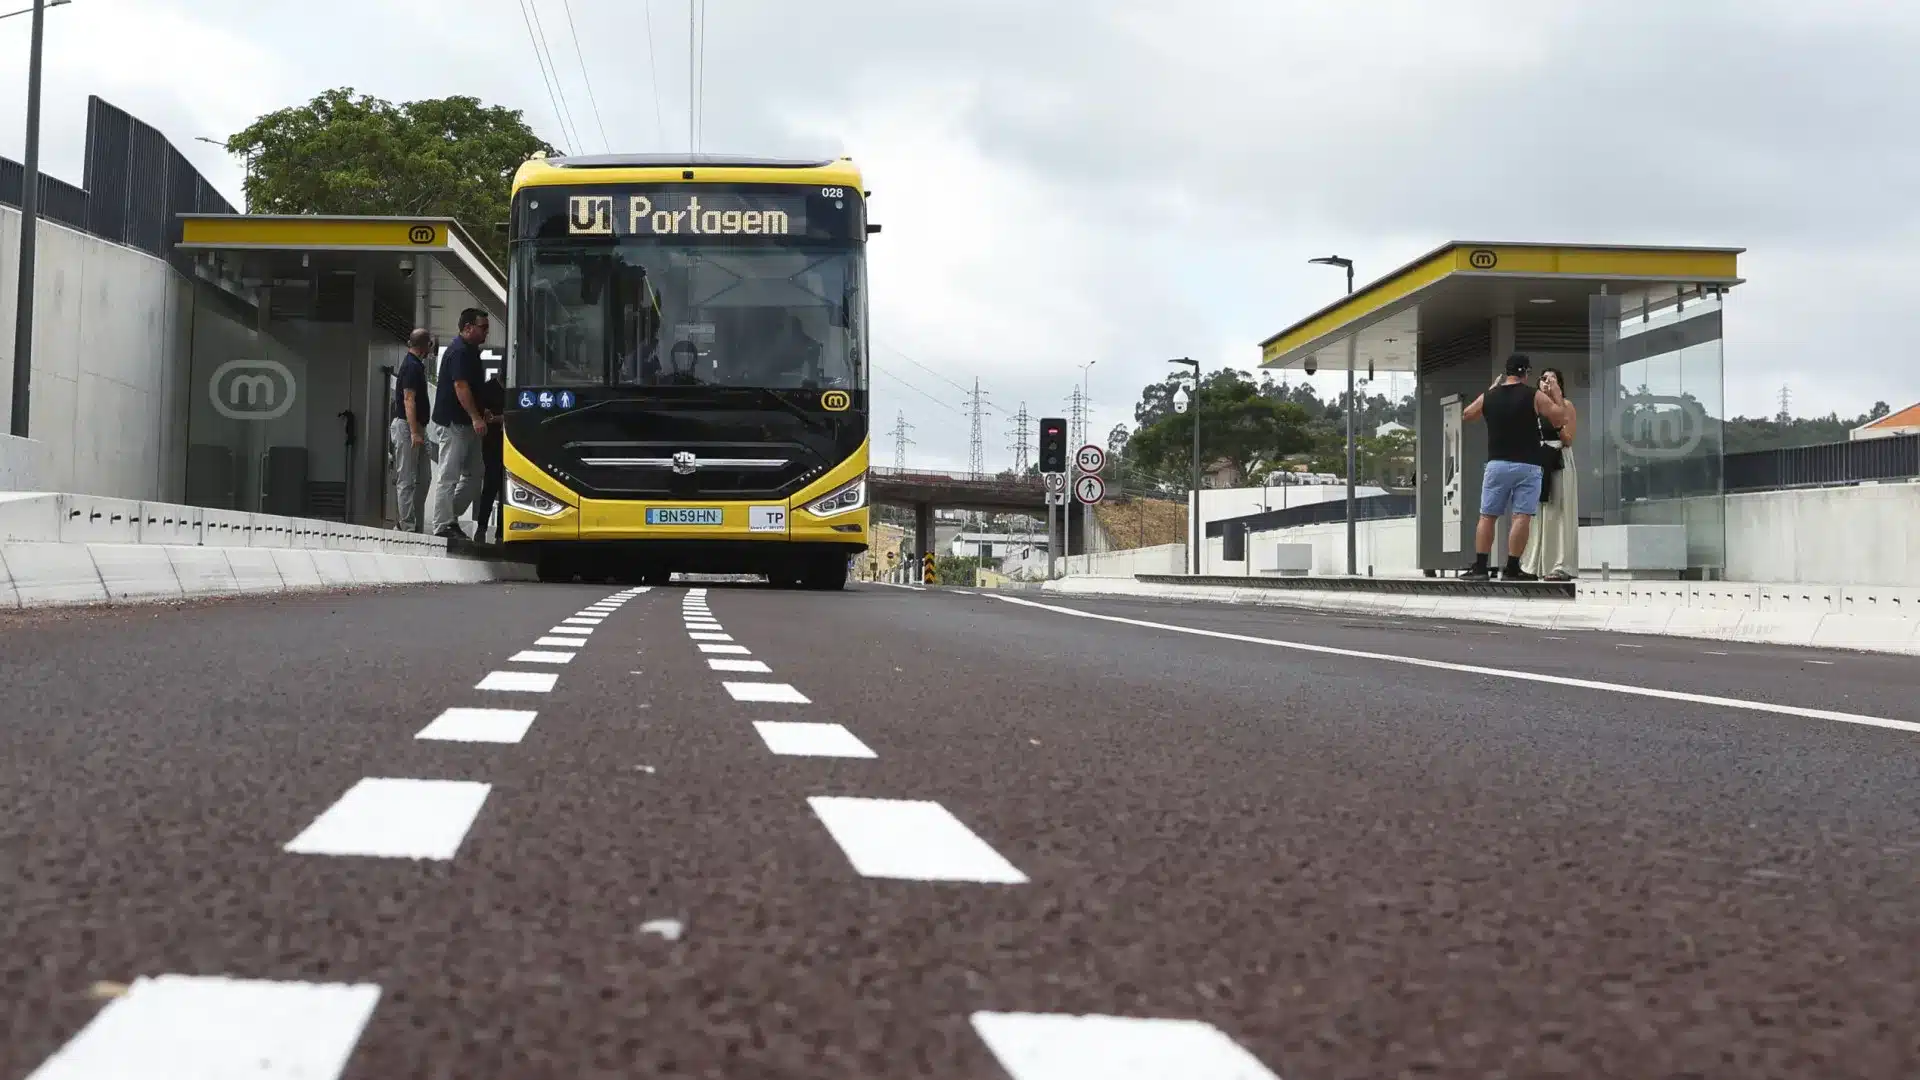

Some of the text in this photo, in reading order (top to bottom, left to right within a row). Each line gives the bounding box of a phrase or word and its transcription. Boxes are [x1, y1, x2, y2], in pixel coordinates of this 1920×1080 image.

[822, 187, 844, 199] 028
[570, 196, 788, 234] U1 Portagem
[1081, 453, 1100, 465] 50
[766, 512, 784, 524] TP
